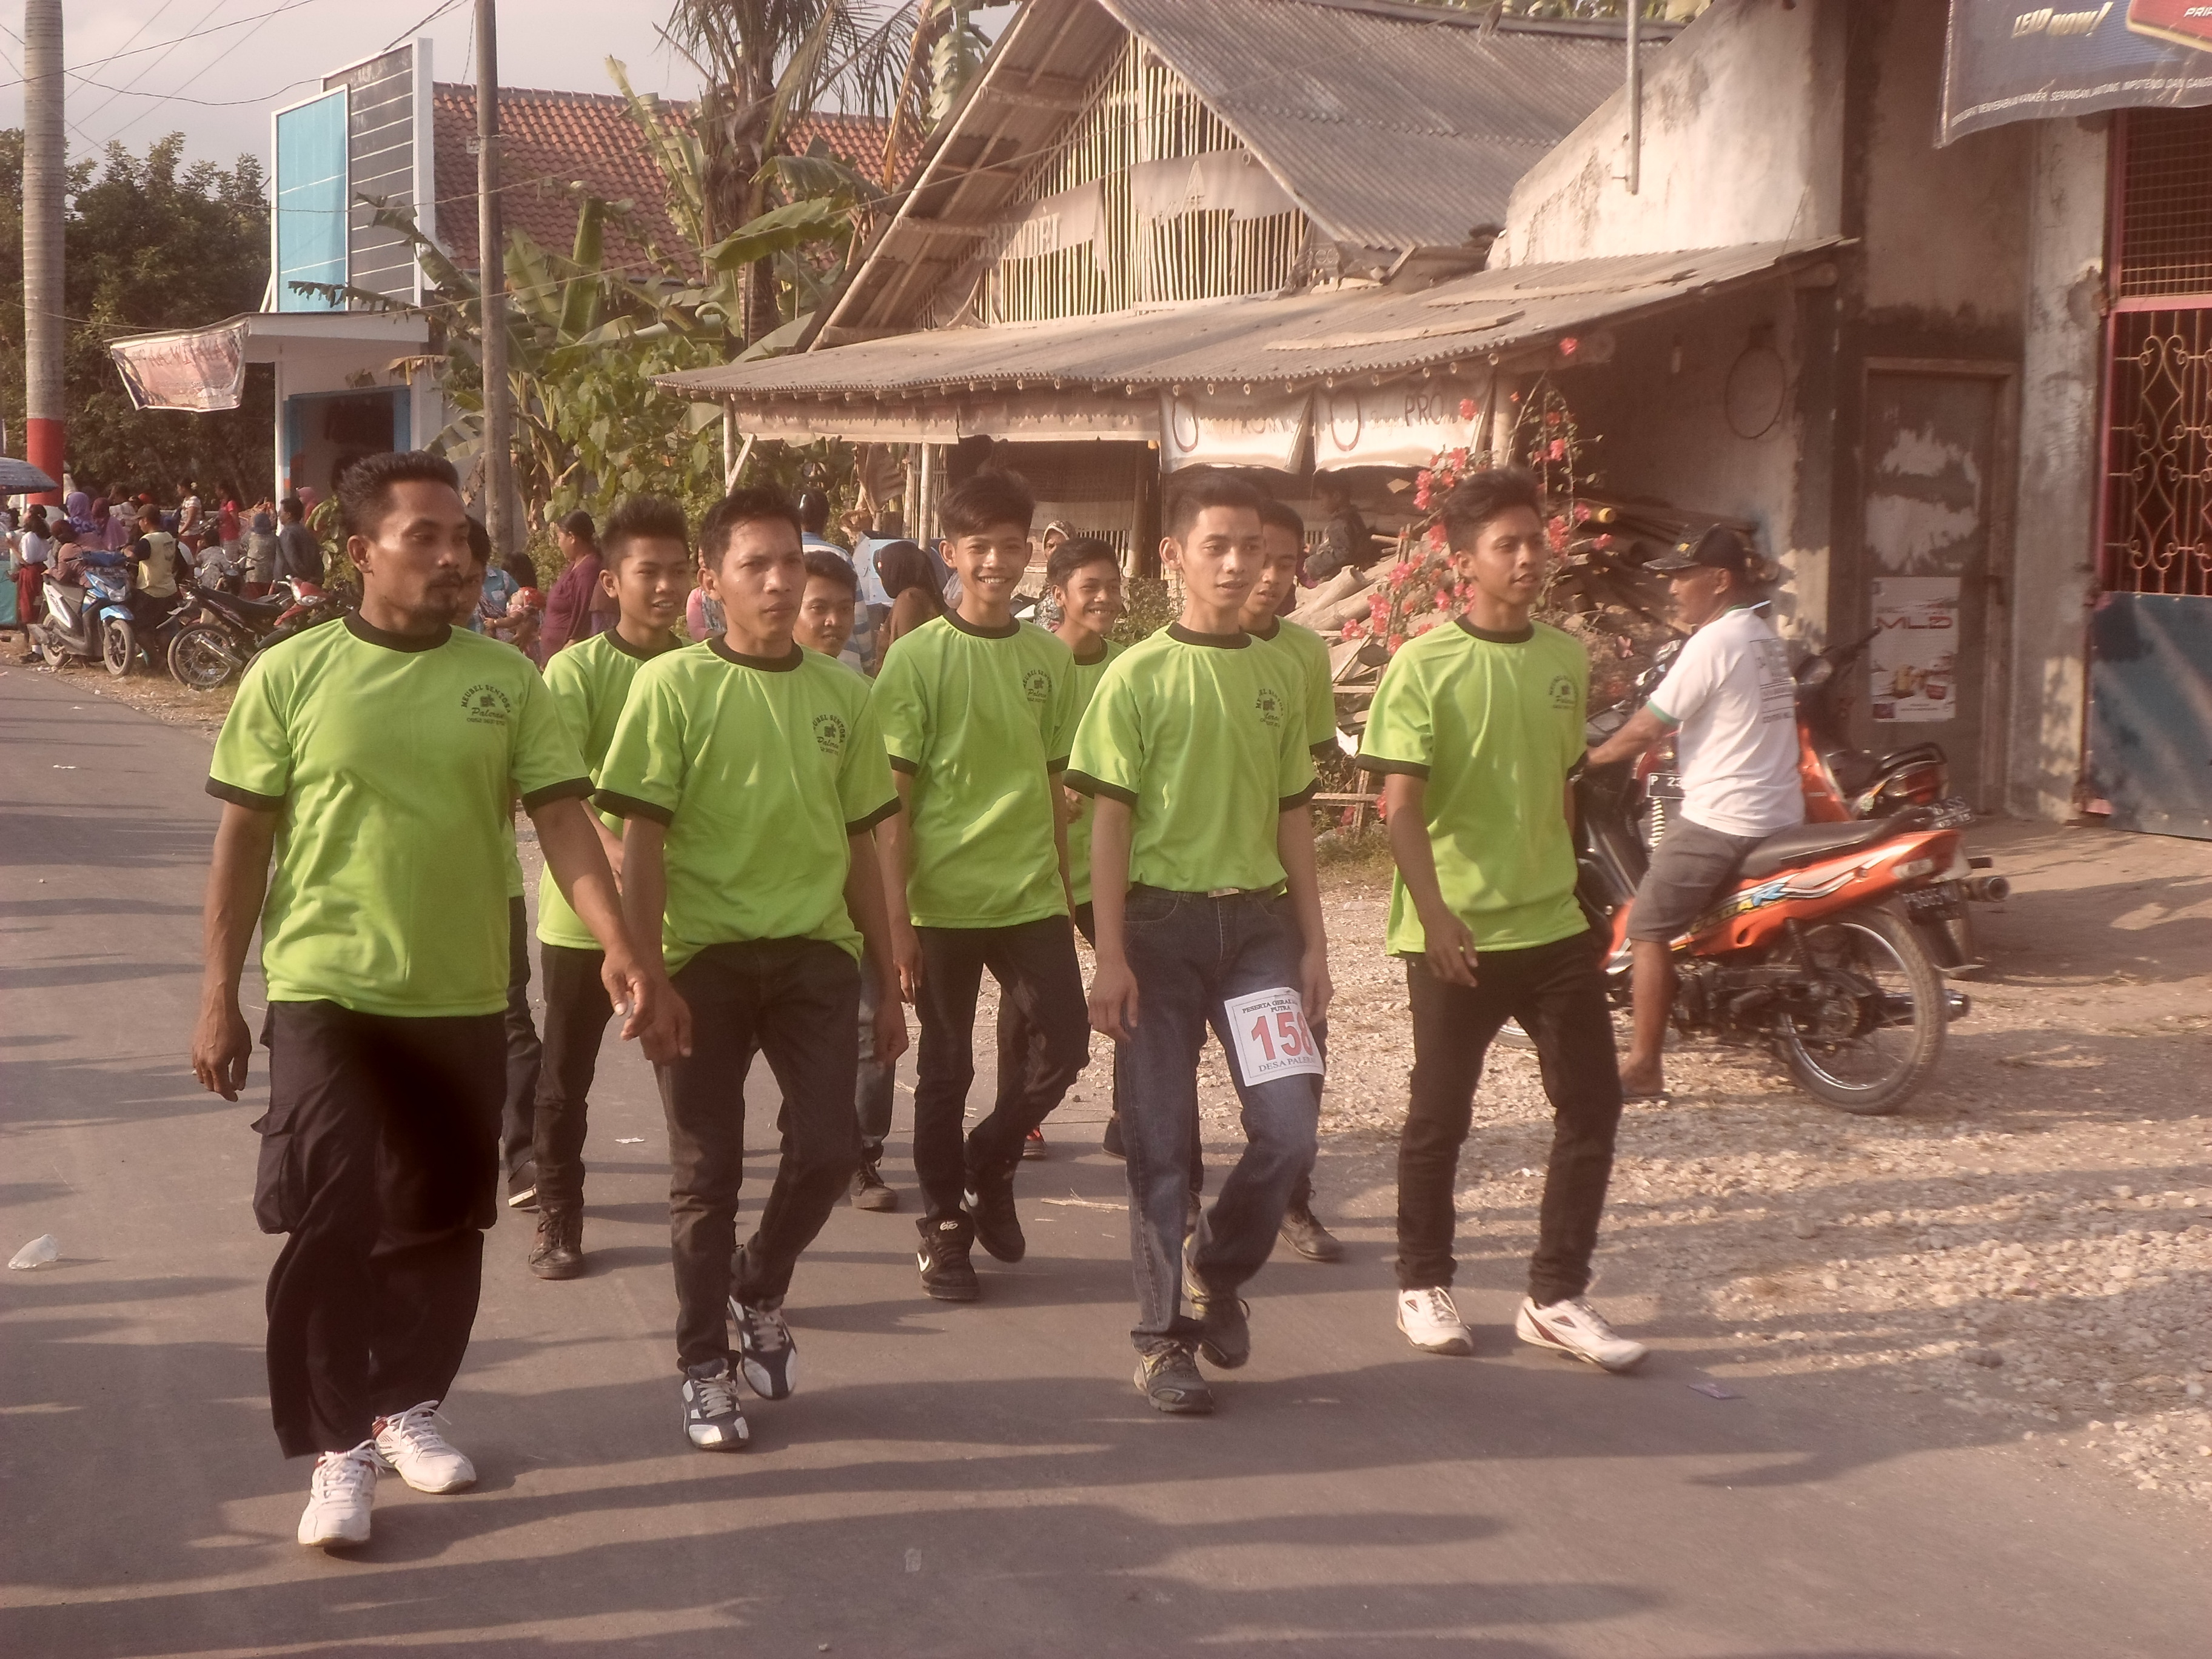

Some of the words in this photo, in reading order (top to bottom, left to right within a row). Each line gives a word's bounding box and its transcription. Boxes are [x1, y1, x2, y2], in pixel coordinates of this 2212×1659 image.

[2046, 1, 2114, 36] NOW!
[1876, 616, 1954, 629] MLD
[461, 685, 483, 708] MEUBEL
[485, 685, 511, 713] SENTOSA
[1242, 1002, 1272, 1014] PESERTA
[1259, 1061, 1287, 1072] DESA
